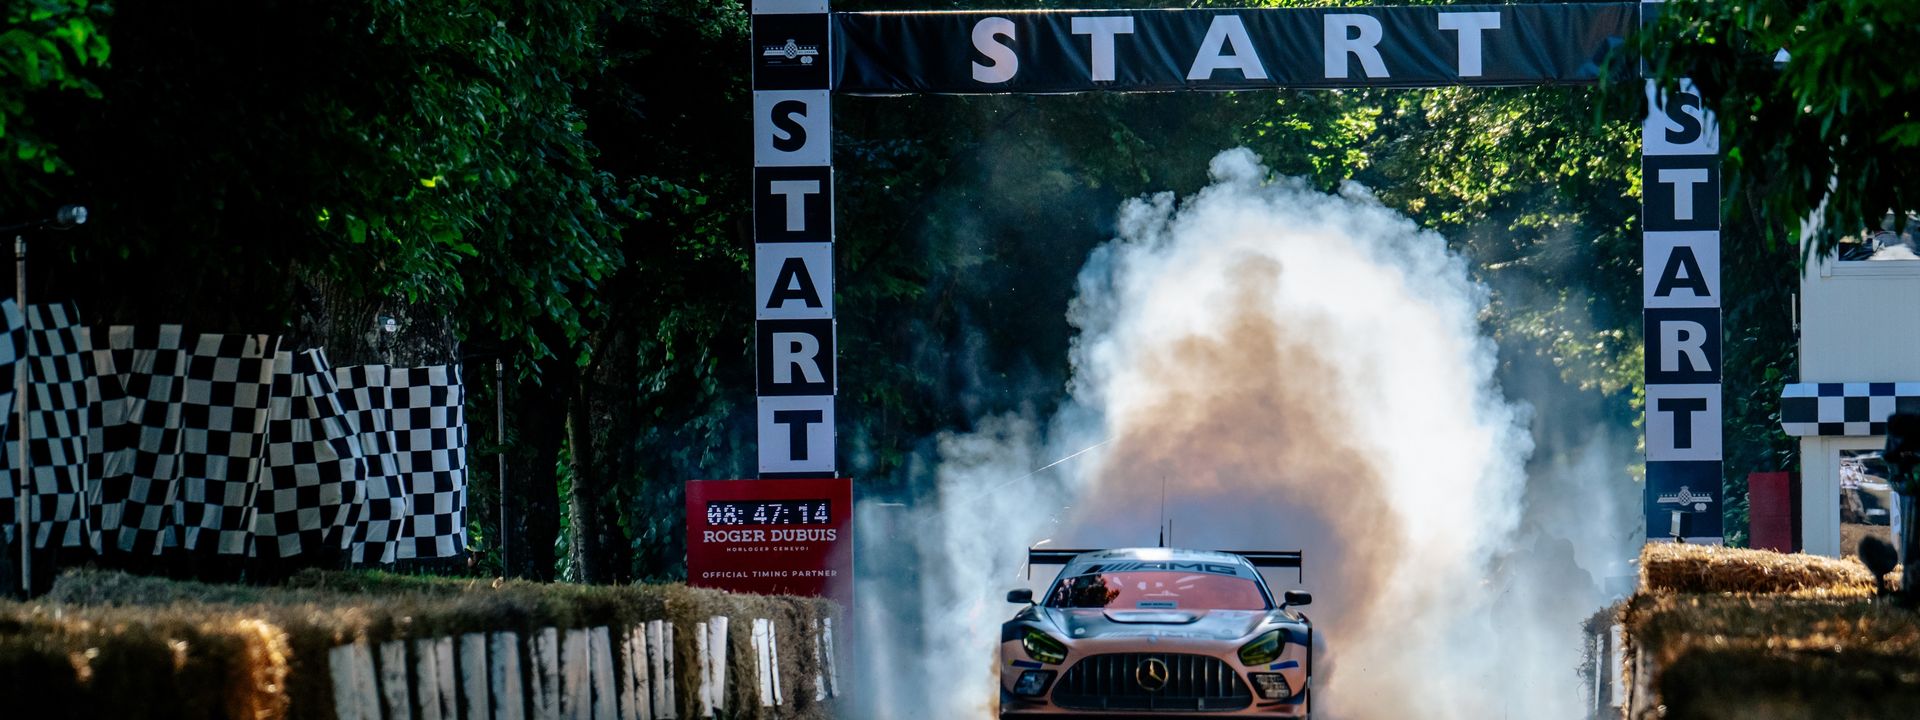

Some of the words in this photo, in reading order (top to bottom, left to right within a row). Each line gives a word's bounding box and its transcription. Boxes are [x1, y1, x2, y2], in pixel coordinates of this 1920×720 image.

[971, 11, 1501, 84] START
[765, 99, 826, 462] START
[1653, 91, 1712, 450] START
[703, 529, 766, 543] ROGER
[770, 528, 837, 542] DUBUIS
[702, 571, 749, 579] OFFICIAL
[752, 570, 788, 578] TIMING
[792, 569, 838, 577] PARTNER
[1130, 562, 1237, 576] AMG
